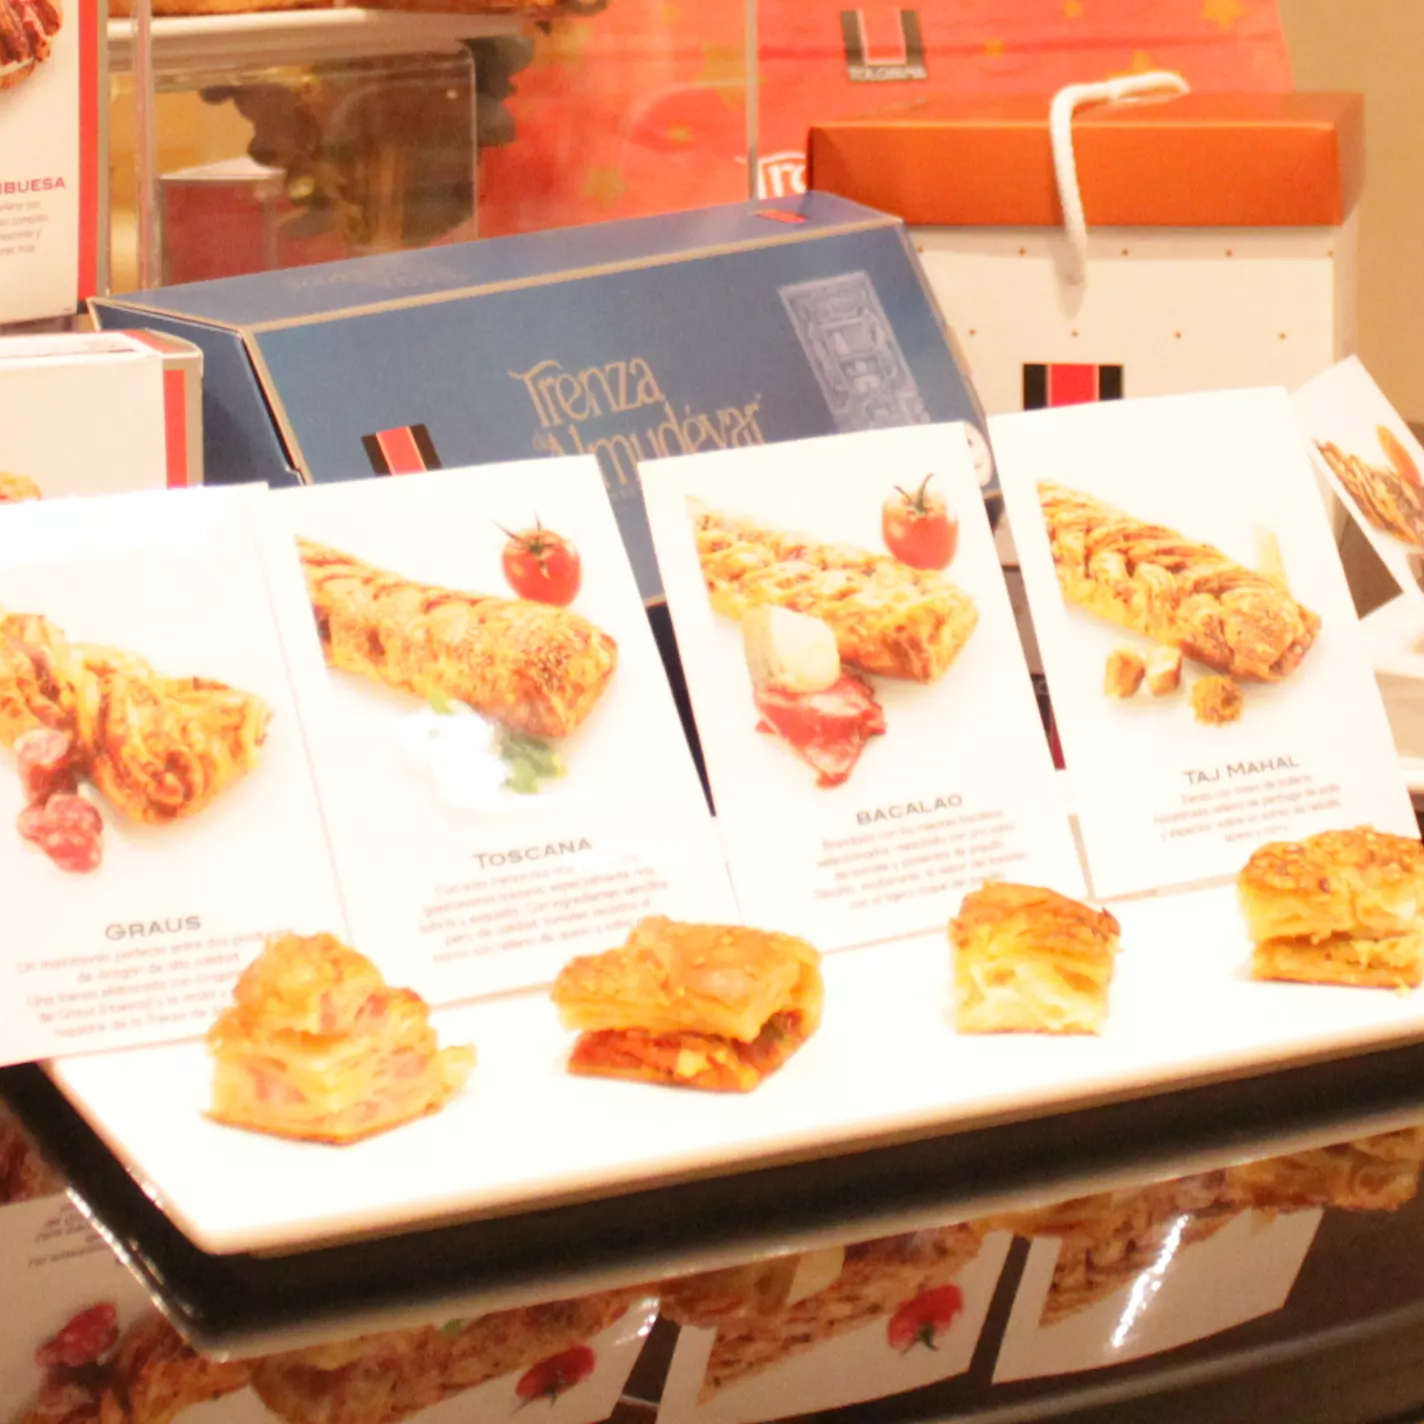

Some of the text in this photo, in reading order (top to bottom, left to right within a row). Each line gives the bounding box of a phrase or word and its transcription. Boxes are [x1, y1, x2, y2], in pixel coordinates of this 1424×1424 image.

[507, 357, 667, 429] Trenza
[1181, 755, 1300, 786] TAJ MAHAL
[855, 793, 963, 826] BACALAO
[471, 837, 593, 870] TOSCANA
[104, 914, 202, 941] GRAUS
